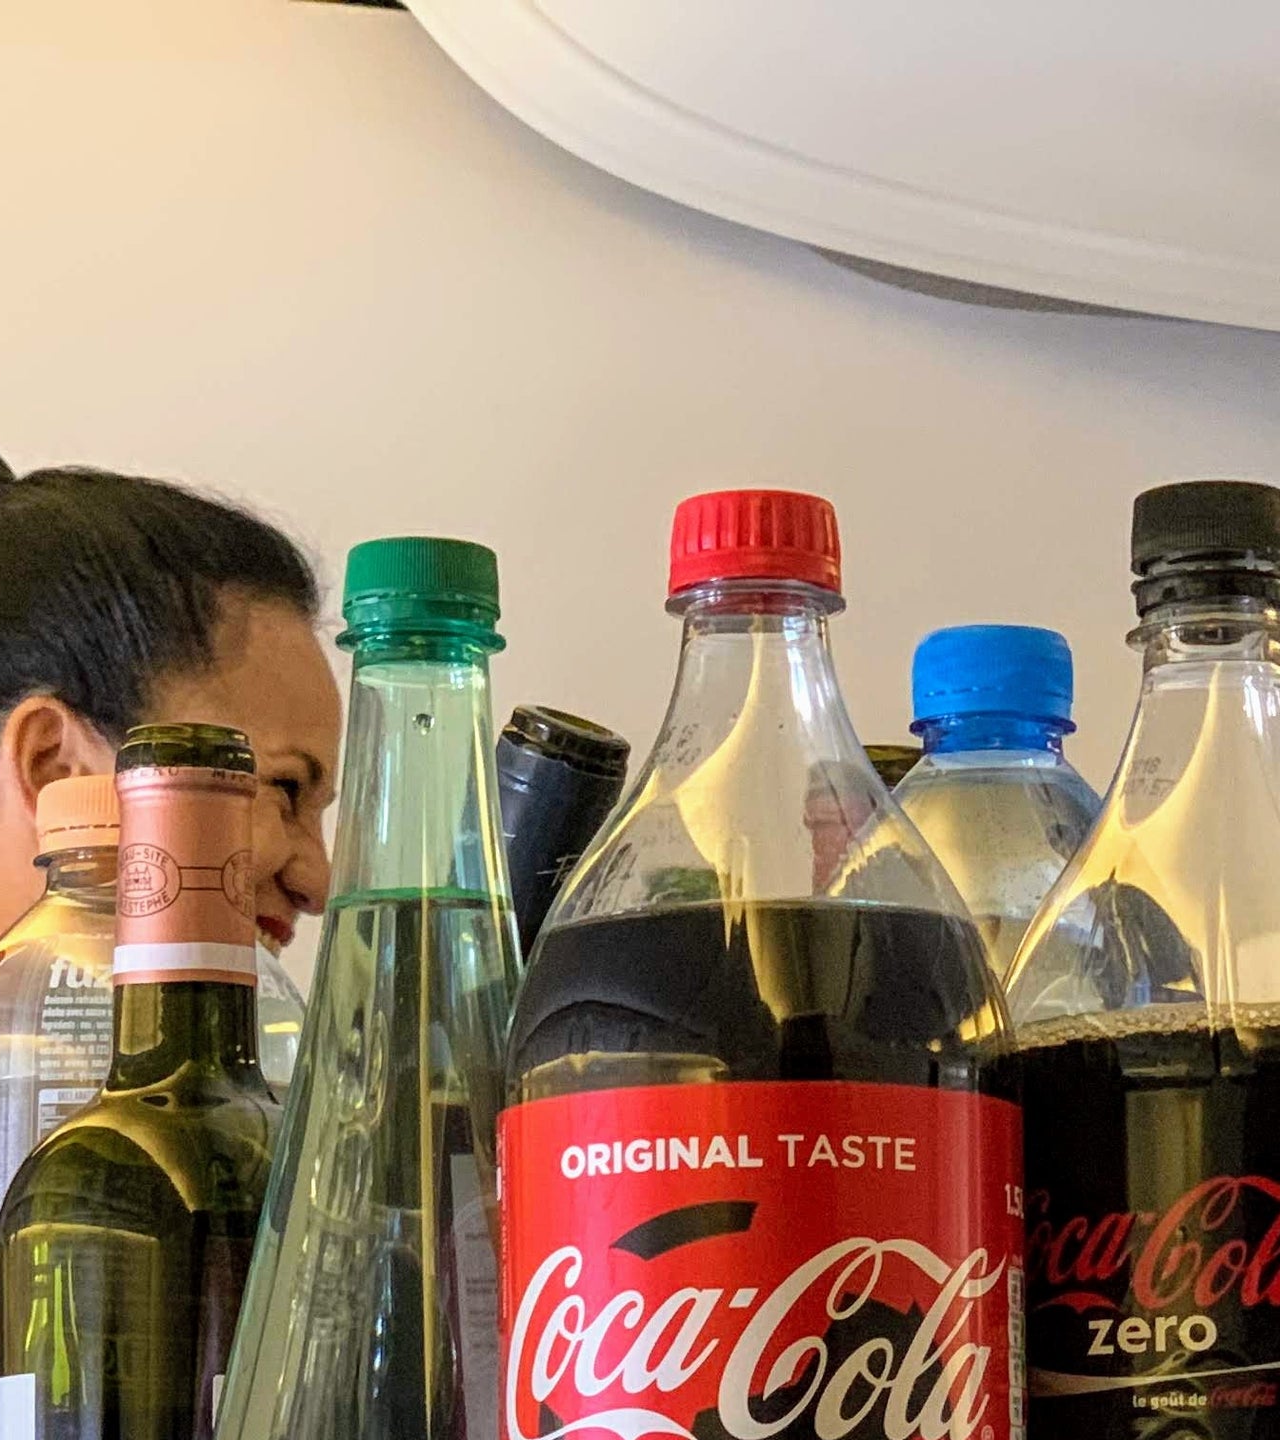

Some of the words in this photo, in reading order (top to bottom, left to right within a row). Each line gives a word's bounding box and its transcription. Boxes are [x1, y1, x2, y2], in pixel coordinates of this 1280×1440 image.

[561, 1135, 764, 1178] ORIGINAL
[777, 1134, 916, 1172] TASTE
[1087, 1312, 1218, 1357] zero
